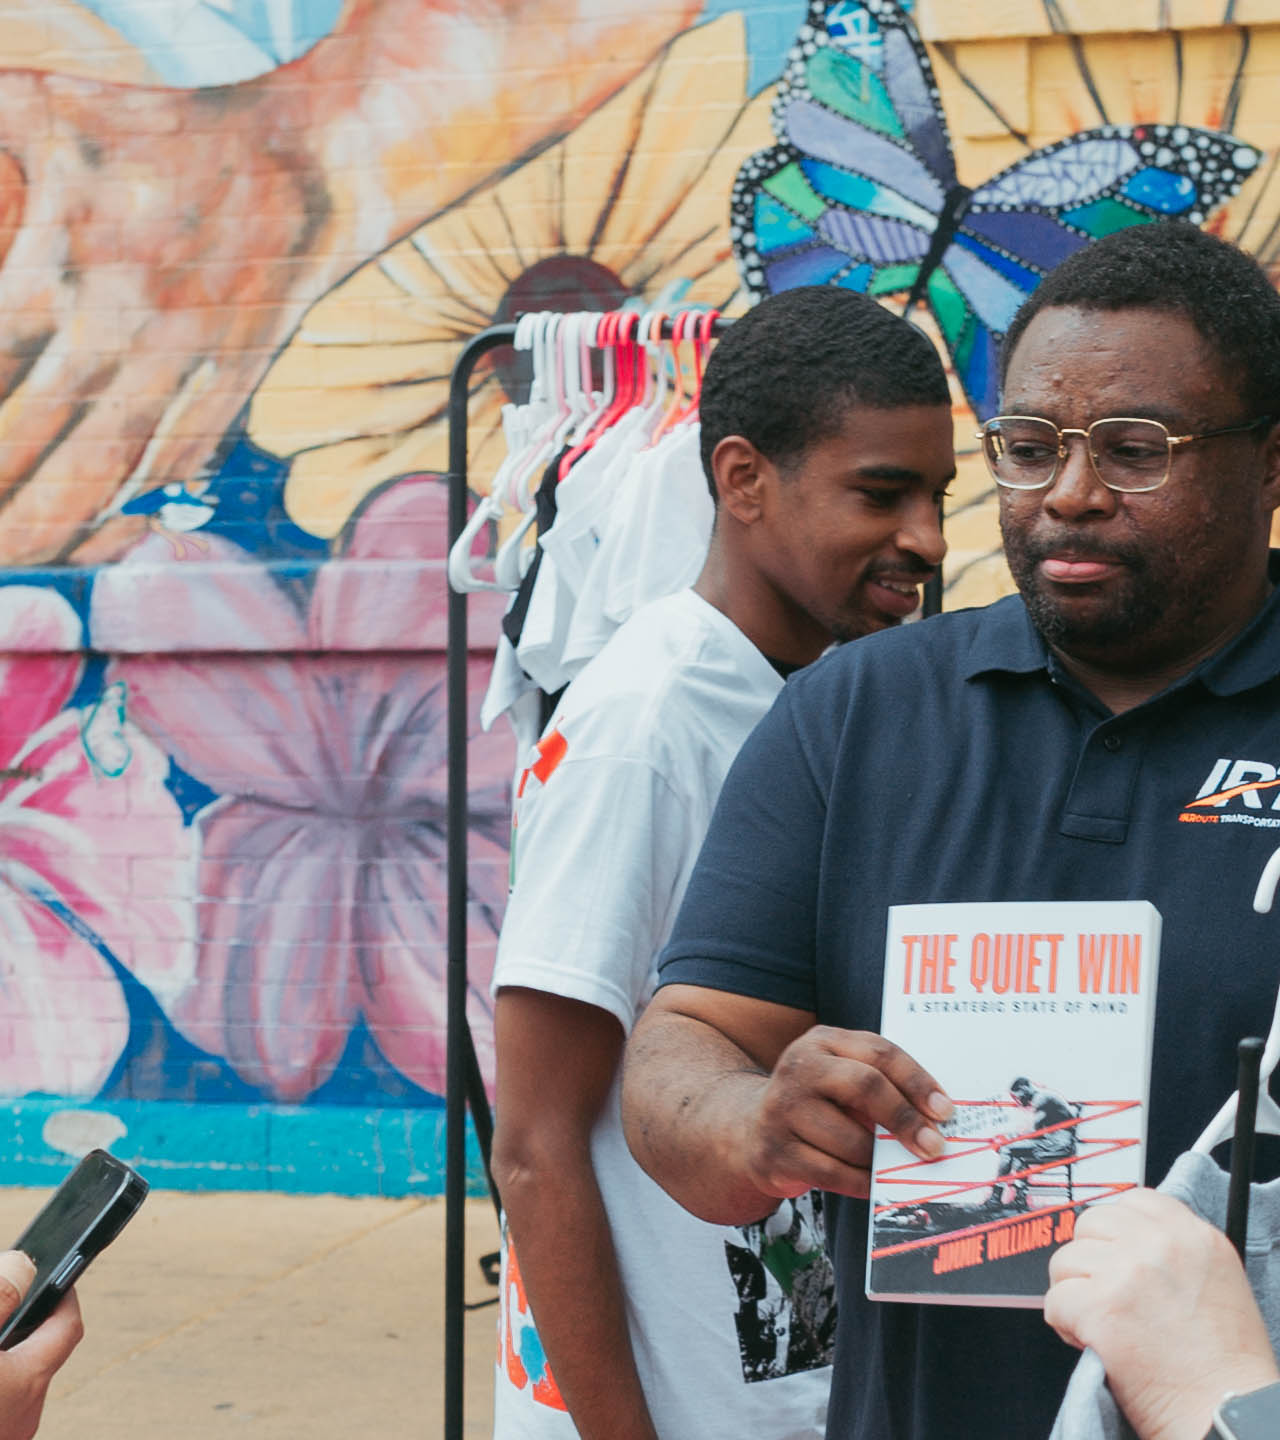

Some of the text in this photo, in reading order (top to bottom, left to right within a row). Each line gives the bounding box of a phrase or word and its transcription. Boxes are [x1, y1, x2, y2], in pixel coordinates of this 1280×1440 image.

[901, 932, 1143, 995] THE QUIET WIN
